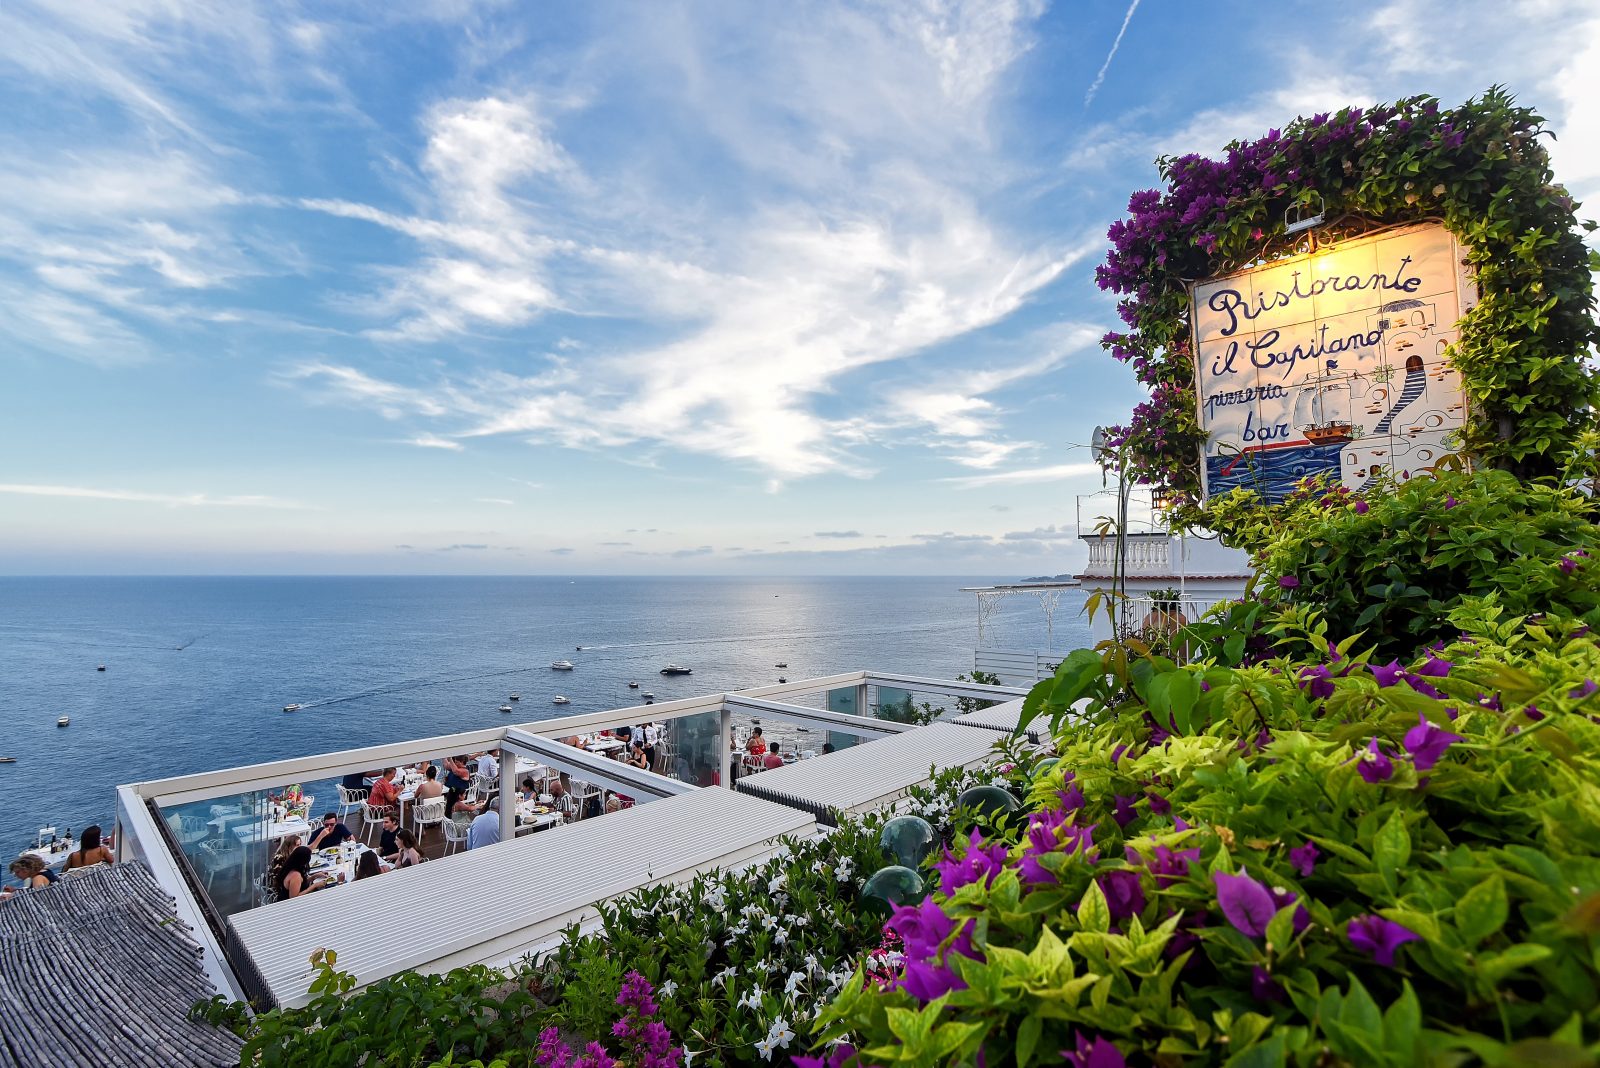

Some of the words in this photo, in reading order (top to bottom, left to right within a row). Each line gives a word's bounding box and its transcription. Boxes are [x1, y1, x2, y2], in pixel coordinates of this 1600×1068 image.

[1209, 255, 1422, 336] Ristorante
[1212, 341, 1238, 376] il
[1246, 323, 1383, 380] Capitano
[1204, 383, 1289, 420] pizzeria
[1242, 411, 1290, 442] bar
